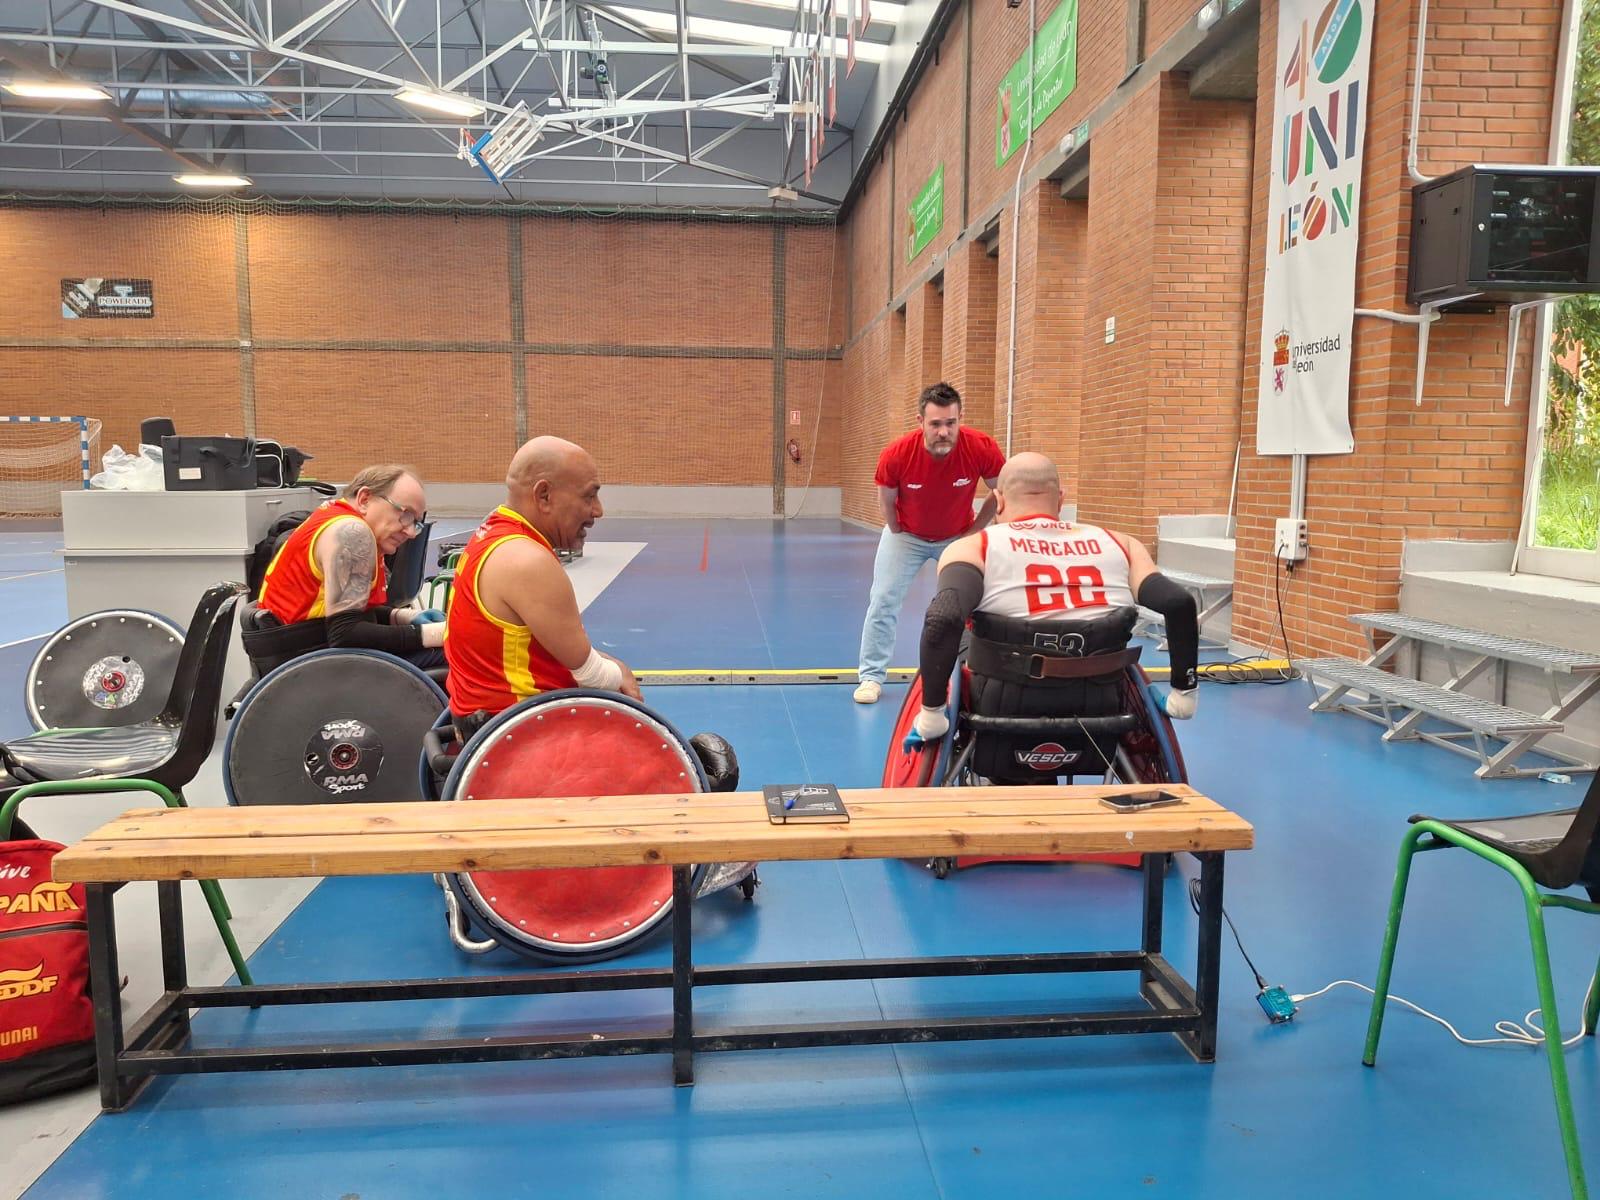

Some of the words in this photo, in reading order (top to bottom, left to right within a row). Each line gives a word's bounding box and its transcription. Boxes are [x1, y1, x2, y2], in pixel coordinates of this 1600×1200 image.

[1282, 79, 1360, 187] UNI
[1278, 181, 1354, 256] LEÓN
[1009, 537, 1102, 557] MERCADO
[1033, 632, 1085, 657] 53
[321, 728, 366, 740] RMA
[1017, 752, 1080, 763] VESCO
[323, 773, 369, 787] RMA
[328, 783, 366, 794] Sport
